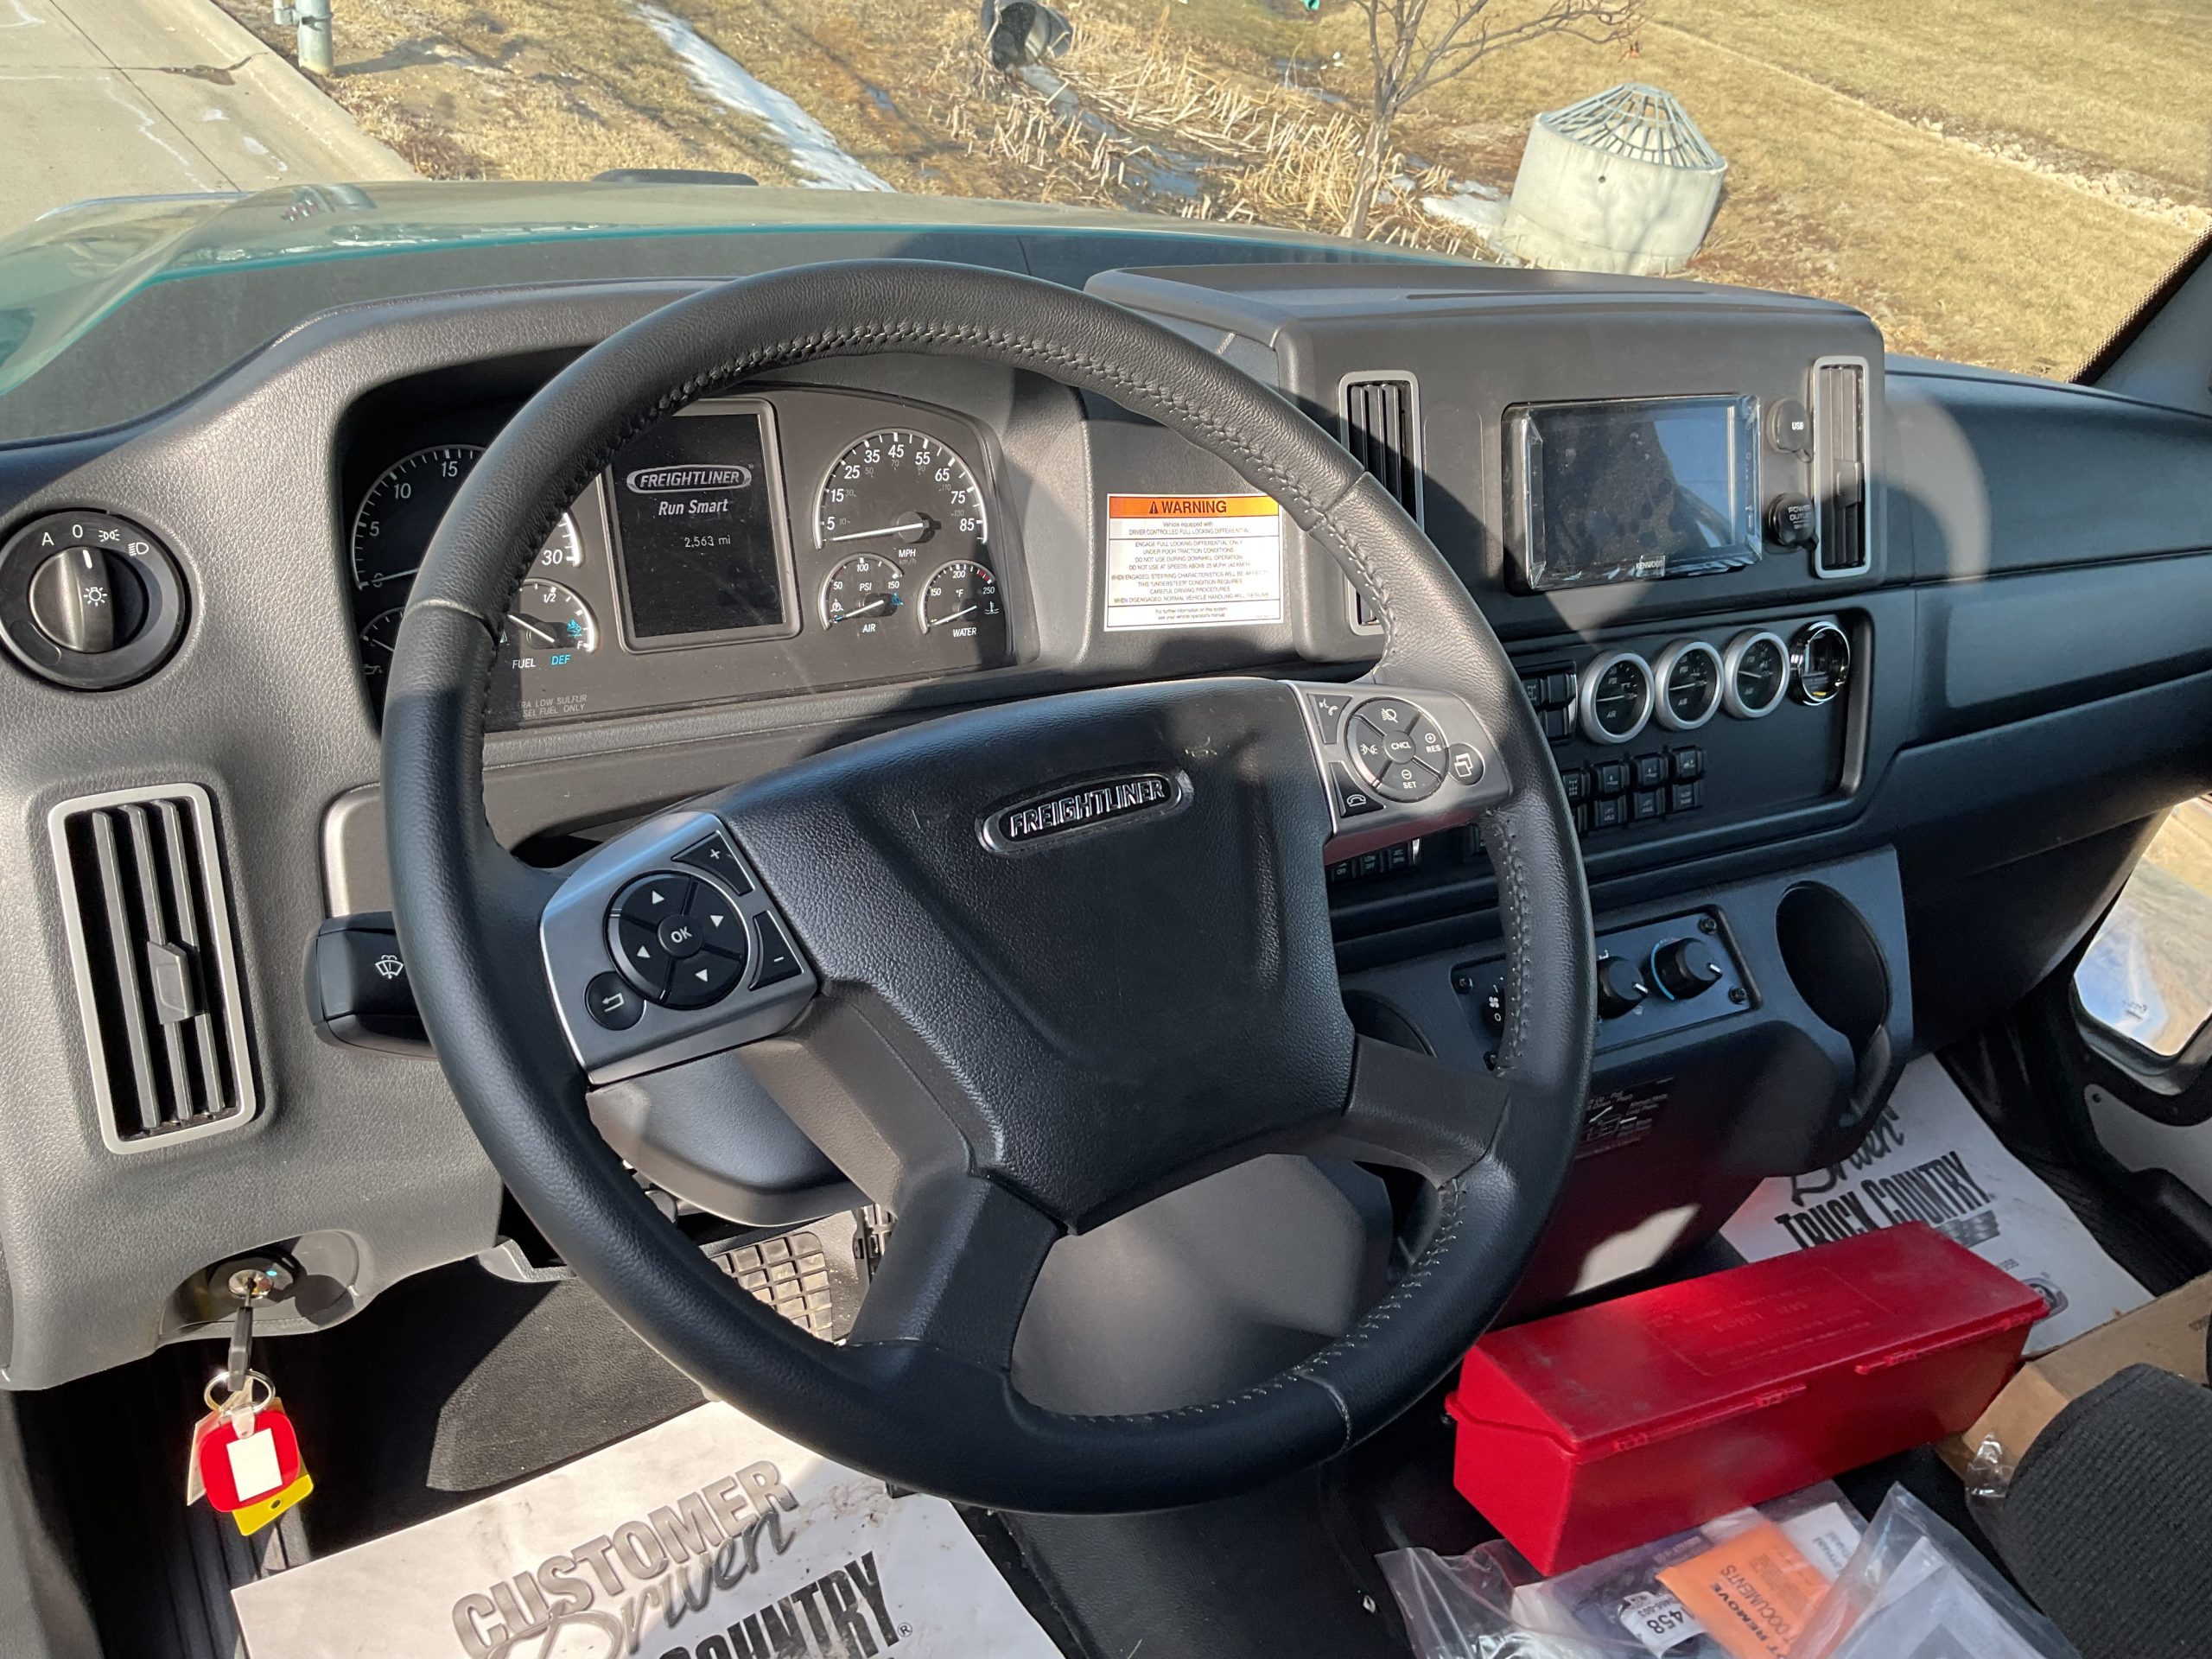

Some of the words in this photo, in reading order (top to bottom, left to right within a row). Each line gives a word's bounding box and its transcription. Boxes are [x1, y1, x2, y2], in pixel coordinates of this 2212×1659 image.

[1791, 422, 1804, 430] USB
[864, 449, 880, 463] 35
[888, 444, 905, 458] 45
[915, 451, 931, 465] 55
[442, 461, 458, 477] 15
[891, 459, 899, 467] 70
[844, 465, 861, 480] 25
[865, 467, 874, 475] 50
[935, 467, 950, 481] 65
[639, 470, 740, 488] FREIGHTLINER
[393, 482, 412, 499] 10
[830, 488, 844, 502] 15
[951, 490, 966, 504] 75
[658, 501, 684, 516] Run
[688, 498, 728, 514] Smart
[1161, 500, 1227, 514] WARNING
[370, 523, 379, 537] 5
[827, 516, 835, 530] 5
[959, 518, 975, 531] 85
[41, 532, 54, 546] A
[718, 534, 731, 545] mi
[542, 550, 563, 566] 30
[899, 549, 916, 558] MPH
[856, 563, 869, 572] 100
[953, 570, 966, 579] 200
[833, 582, 843, 590] 50
[859, 582, 872, 591] PSI
[888, 581, 899, 589] 150
[931, 588, 942, 596] 150
[982, 587, 995, 595] 250
[862, 624, 876, 632] AIR
[953, 627, 977, 637] WATER
[576, 640, 584, 649] F
[512, 658, 536, 670] FUEL
[551, 654, 571, 664] DEF
[536, 698, 553, 708] LOW
[556, 694, 588, 705] SULFUR
[539, 707, 559, 715] FUEL
[563, 703, 585, 713] ONLY
[1606, 710, 1617, 719] AIR
[1390, 741, 1411, 750] CNCL
[1010, 779, 1165, 837] FREIGHTLINER
[671, 926, 692, 943] OK
[1774, 1191, 1881, 1250] TRUCK
[1860, 1151, 1991, 1225] COUNTRY
[451, 1460, 799, 1659] CUSTOMER
[1720, 1565, 1790, 1635] DOCUMENTS
[1710, 1582, 1768, 1641] REMOVE
